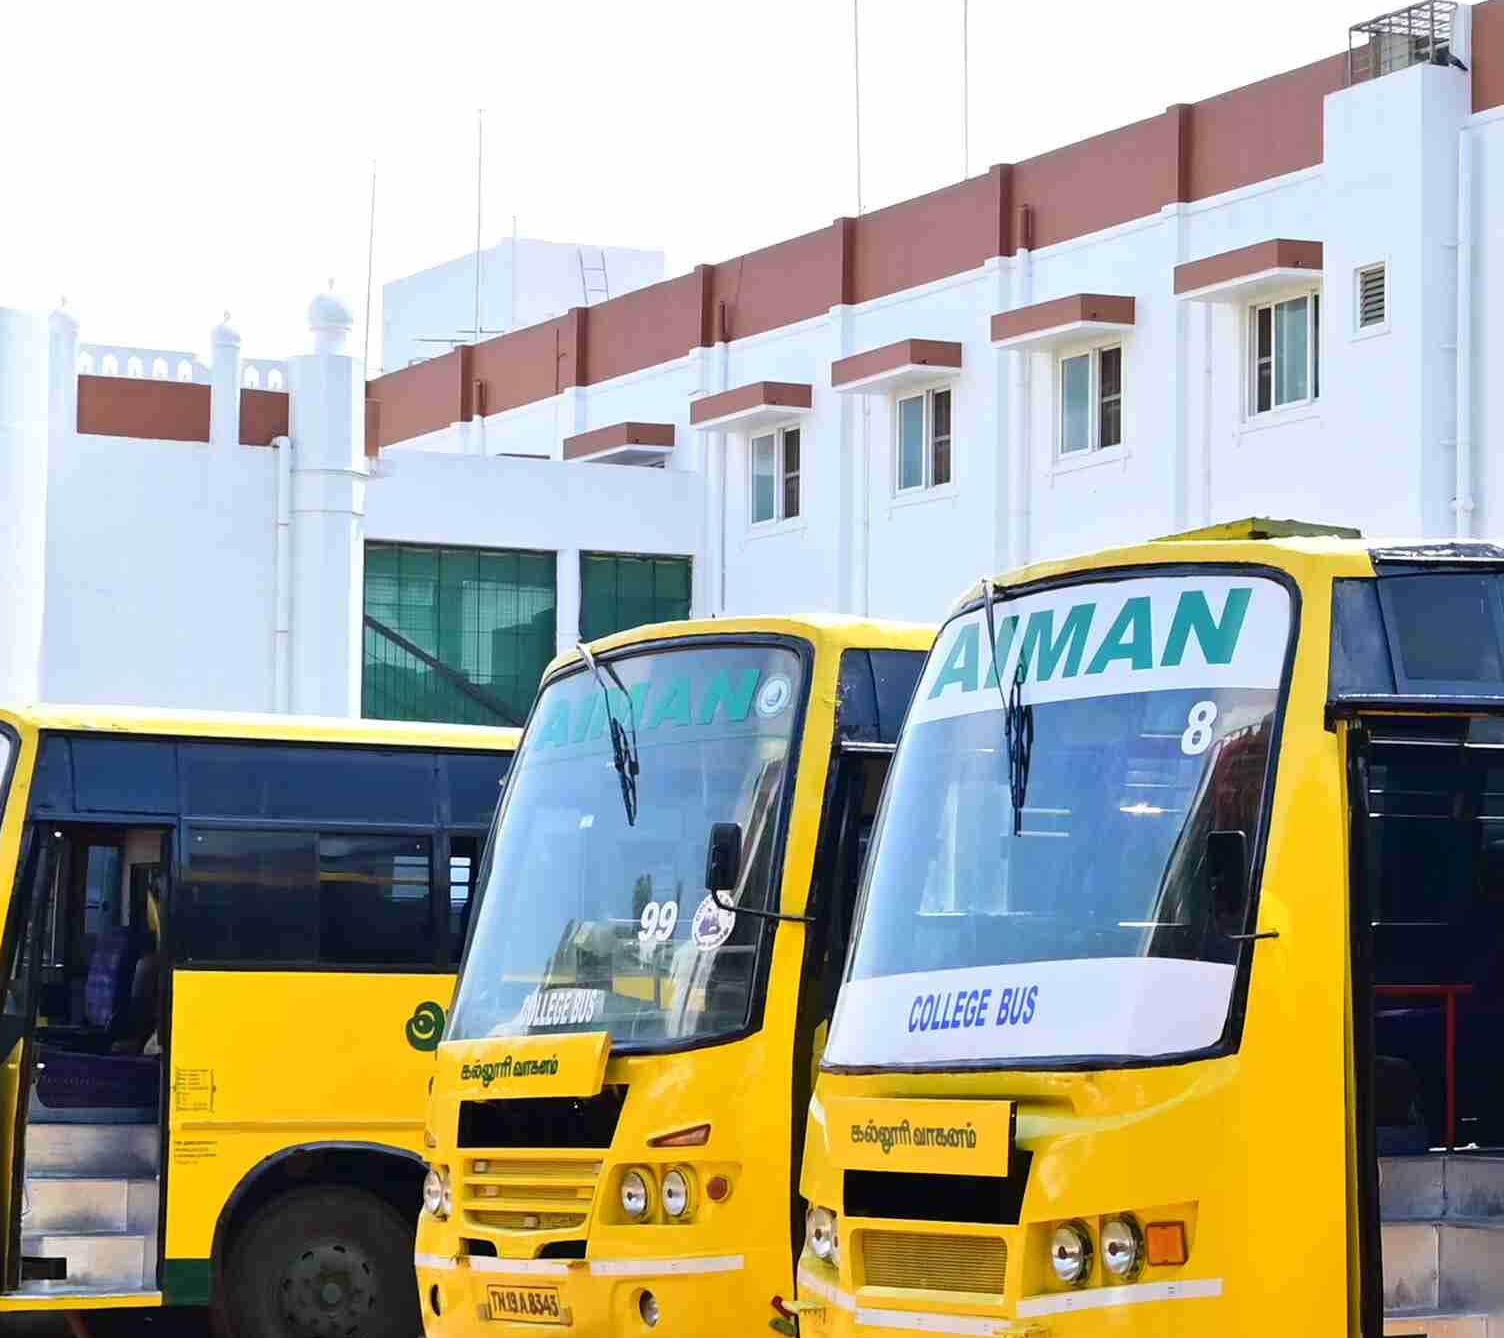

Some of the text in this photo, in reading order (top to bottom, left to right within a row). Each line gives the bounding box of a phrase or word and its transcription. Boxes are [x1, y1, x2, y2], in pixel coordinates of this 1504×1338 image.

[927, 587, 1253, 701] AIMAN
[1180, 700, 1218, 756] 8
[638, 902, 678, 941] 99
[908, 984, 1038, 1032] COLLEGE BUS
